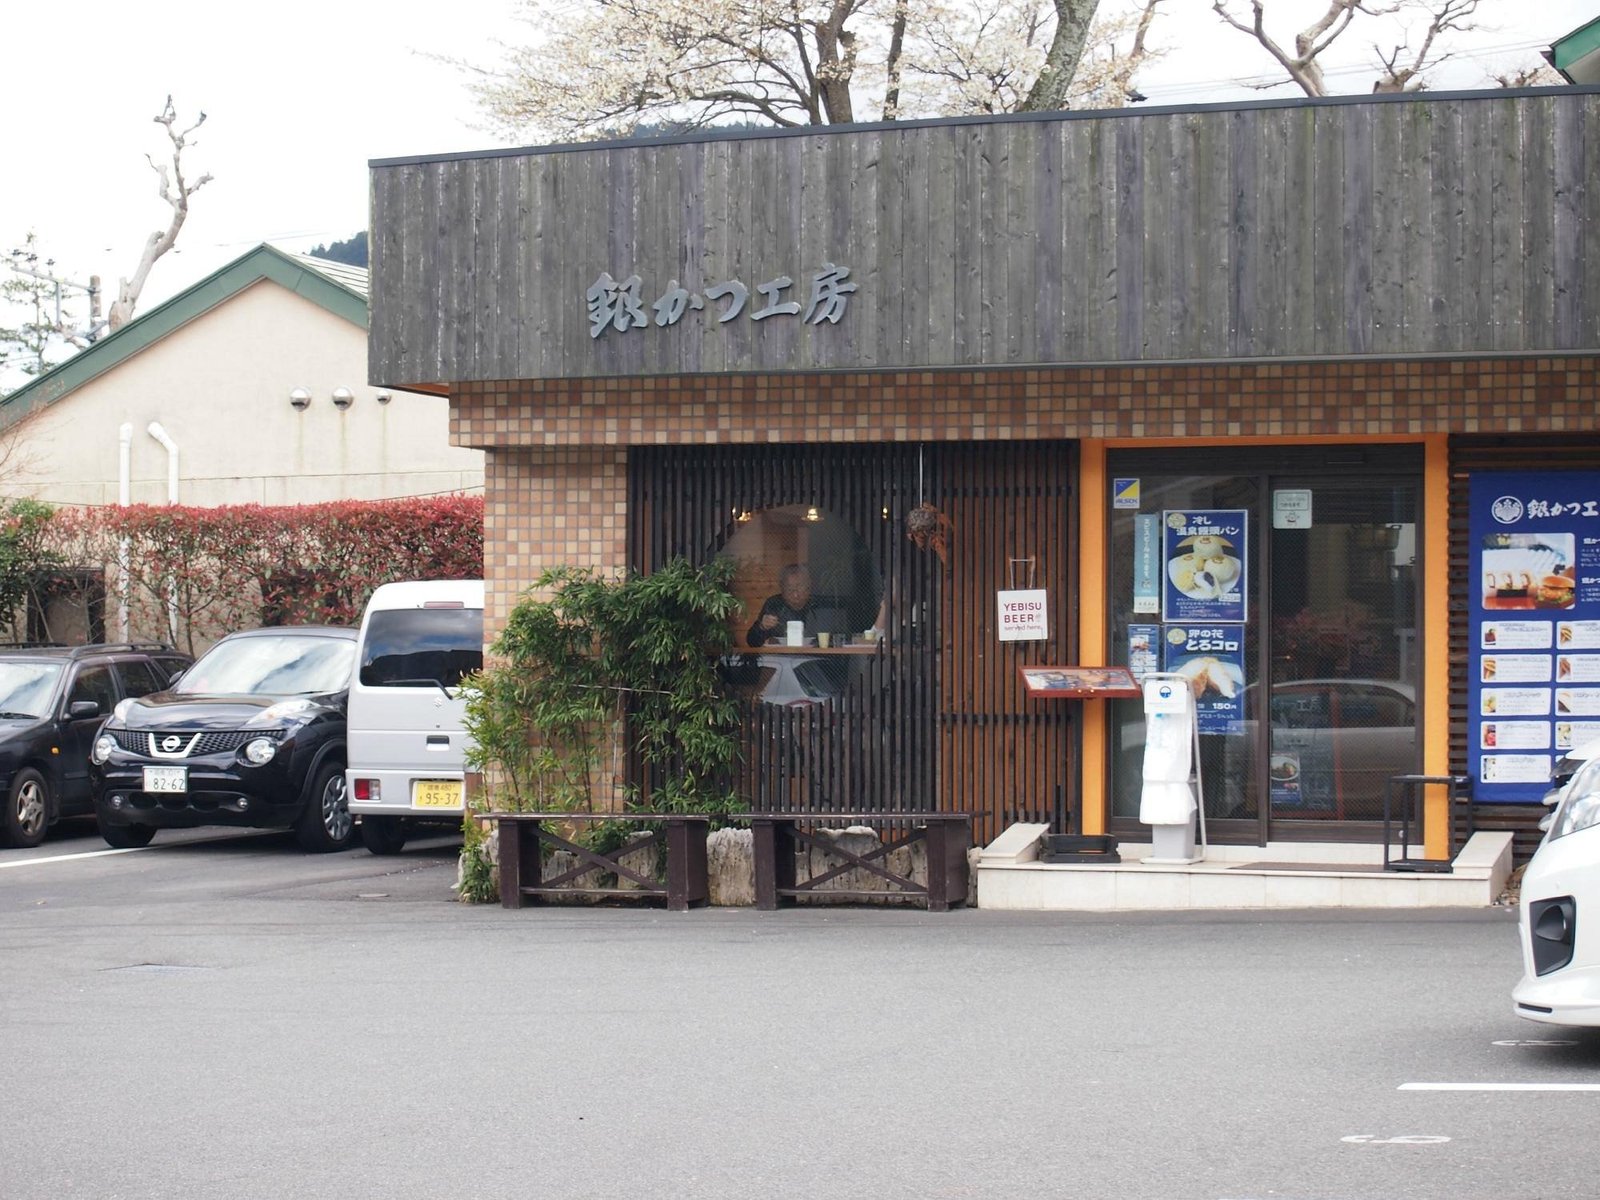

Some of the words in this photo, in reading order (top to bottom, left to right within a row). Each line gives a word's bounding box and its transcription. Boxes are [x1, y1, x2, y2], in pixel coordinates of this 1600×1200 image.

[586, 261, 859, 339] 銀かつ工房
[1004, 602, 1042, 611] YEBISU
[1004, 614, 1034, 623] BEER
[1188, 629, 1224, 639] 卵の花
[1185, 639, 1239, 651] とろコロ
[153, 777, 185, 790] 82-62
[425, 792, 460, 805] 95-37
